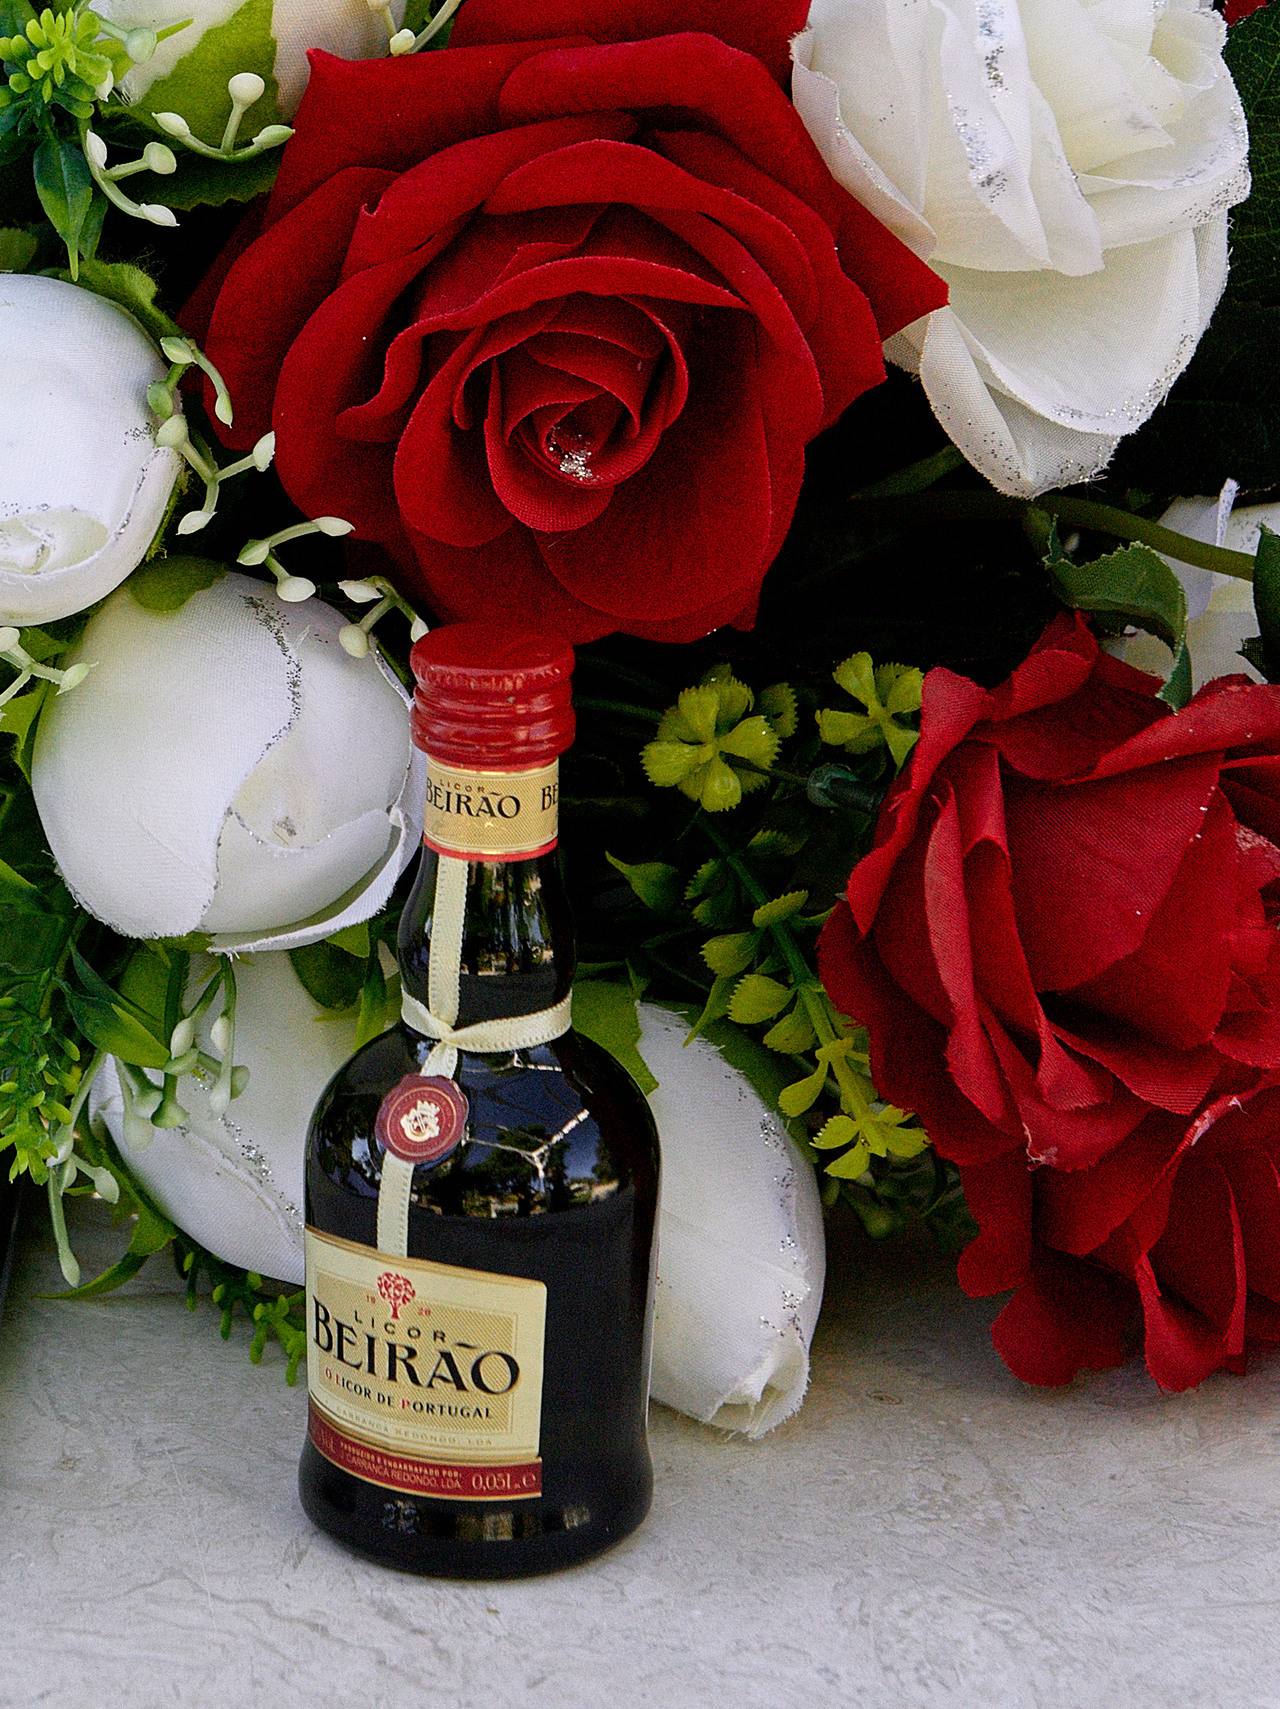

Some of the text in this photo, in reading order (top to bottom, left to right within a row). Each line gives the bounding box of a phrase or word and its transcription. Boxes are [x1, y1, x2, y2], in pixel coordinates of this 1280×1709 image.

[426, 776, 521, 819] BEIRÃO
[439, 778, 485, 794] LICOR
[312, 1294, 521, 1396] BEIRÃO
[354, 1310, 447, 1344] LICOR
[324, 1366, 494, 1420] O LICOR DE PORTUGAL
